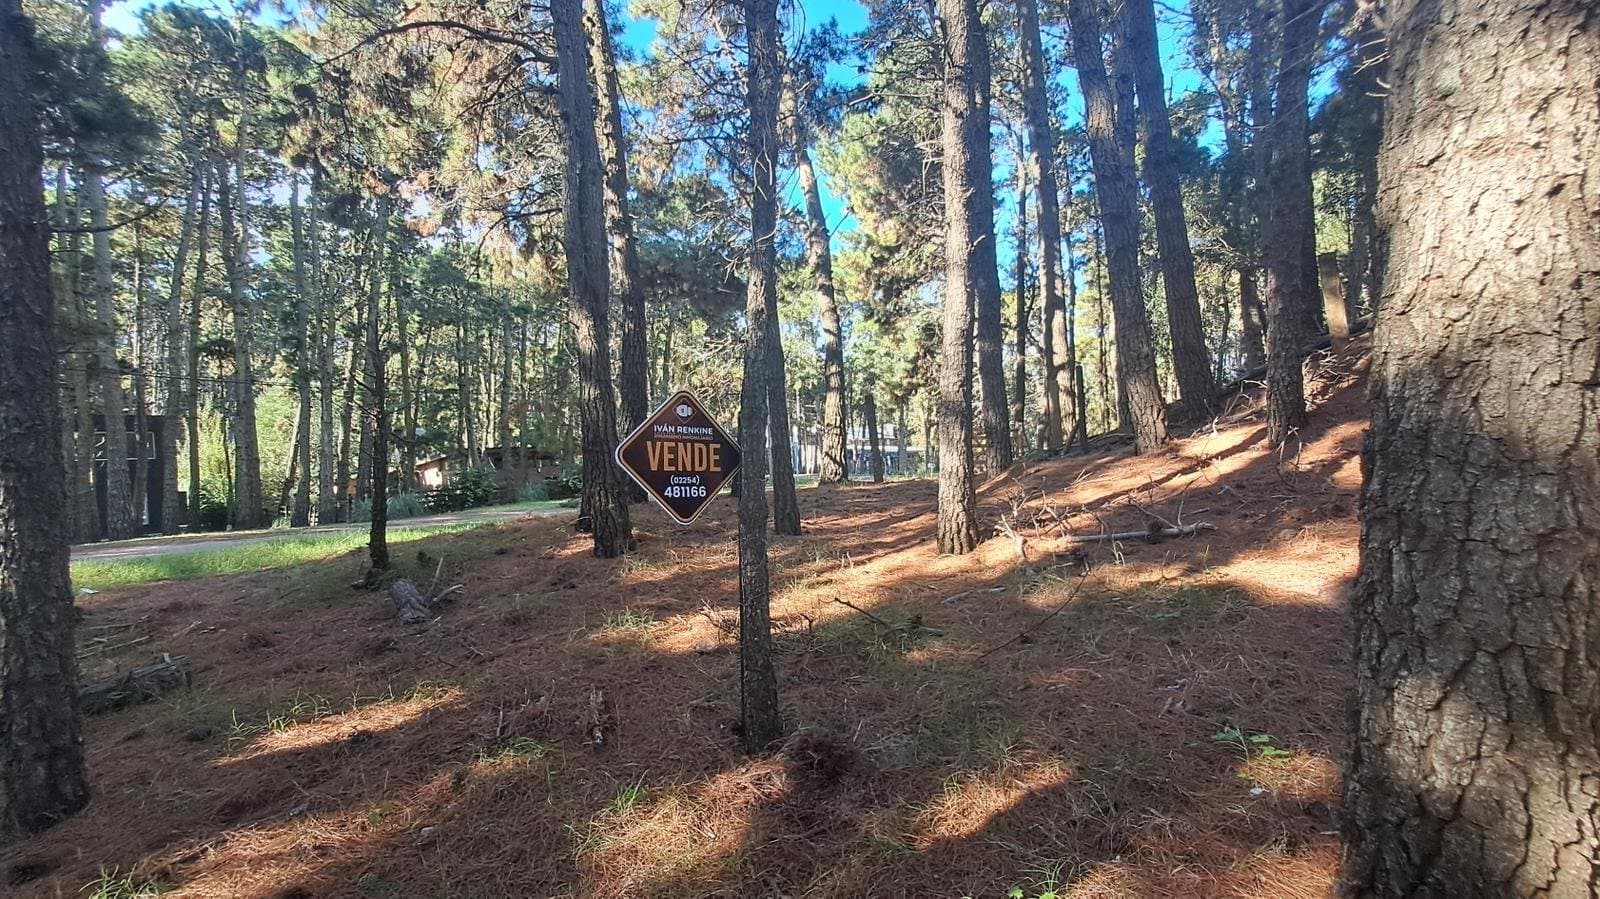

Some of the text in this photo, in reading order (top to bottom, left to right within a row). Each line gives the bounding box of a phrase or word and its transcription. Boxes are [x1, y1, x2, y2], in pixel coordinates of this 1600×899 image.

[654, 424, 714, 435] IVÁN RENKINE
[646, 441, 721, 471] VENDE
[670, 474, 700, 485] (02254)
[664, 486, 707, 498] 481166
